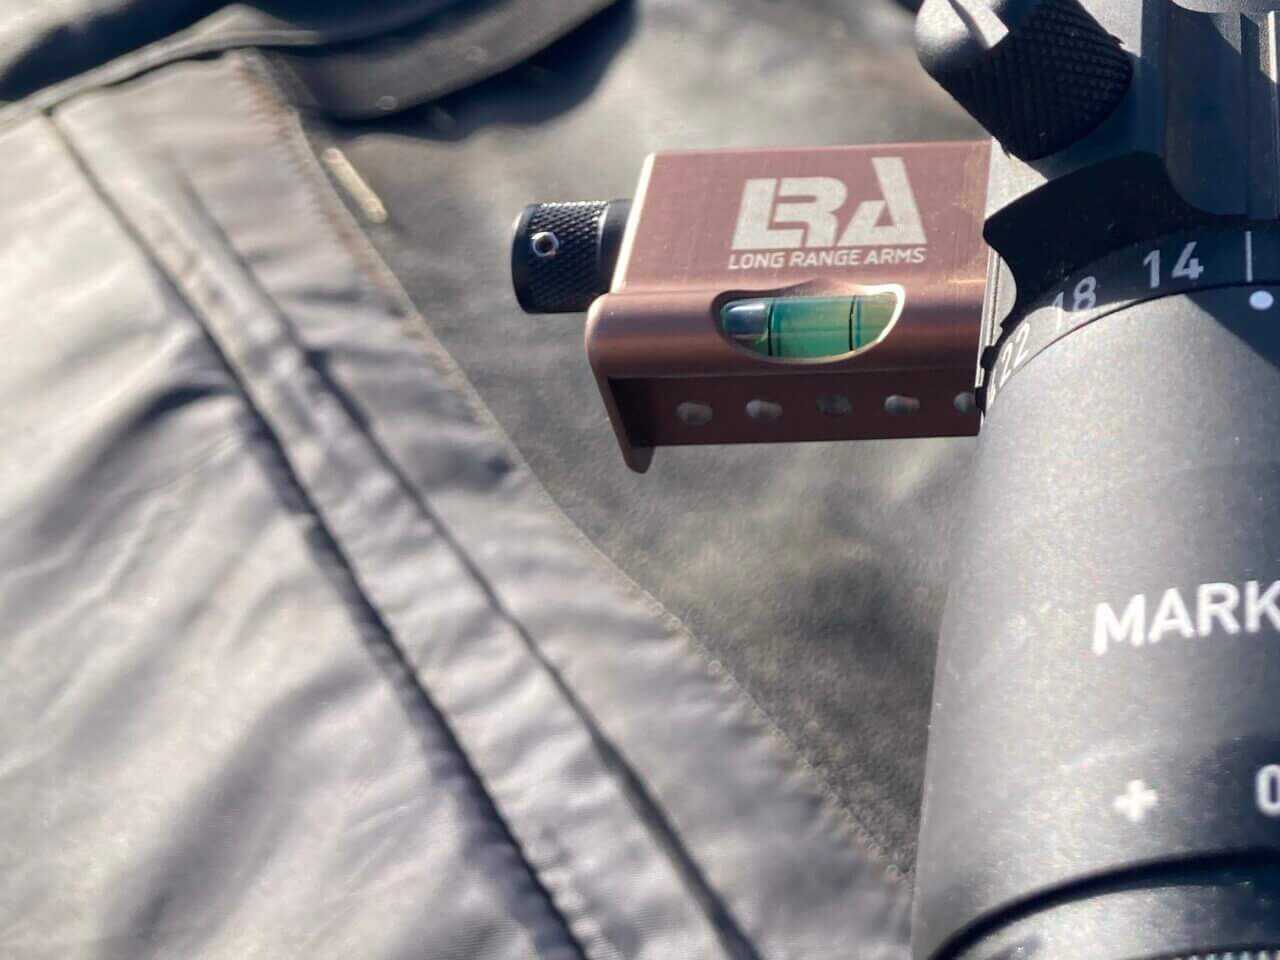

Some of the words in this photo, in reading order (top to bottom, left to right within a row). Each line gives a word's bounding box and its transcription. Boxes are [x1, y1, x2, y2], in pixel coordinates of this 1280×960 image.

[727, 251, 784, 272] LONG
[792, 248, 862, 269] RANGE
[864, 246, 927, 267] ARMS
[1142, 240, 1204, 289] 14
